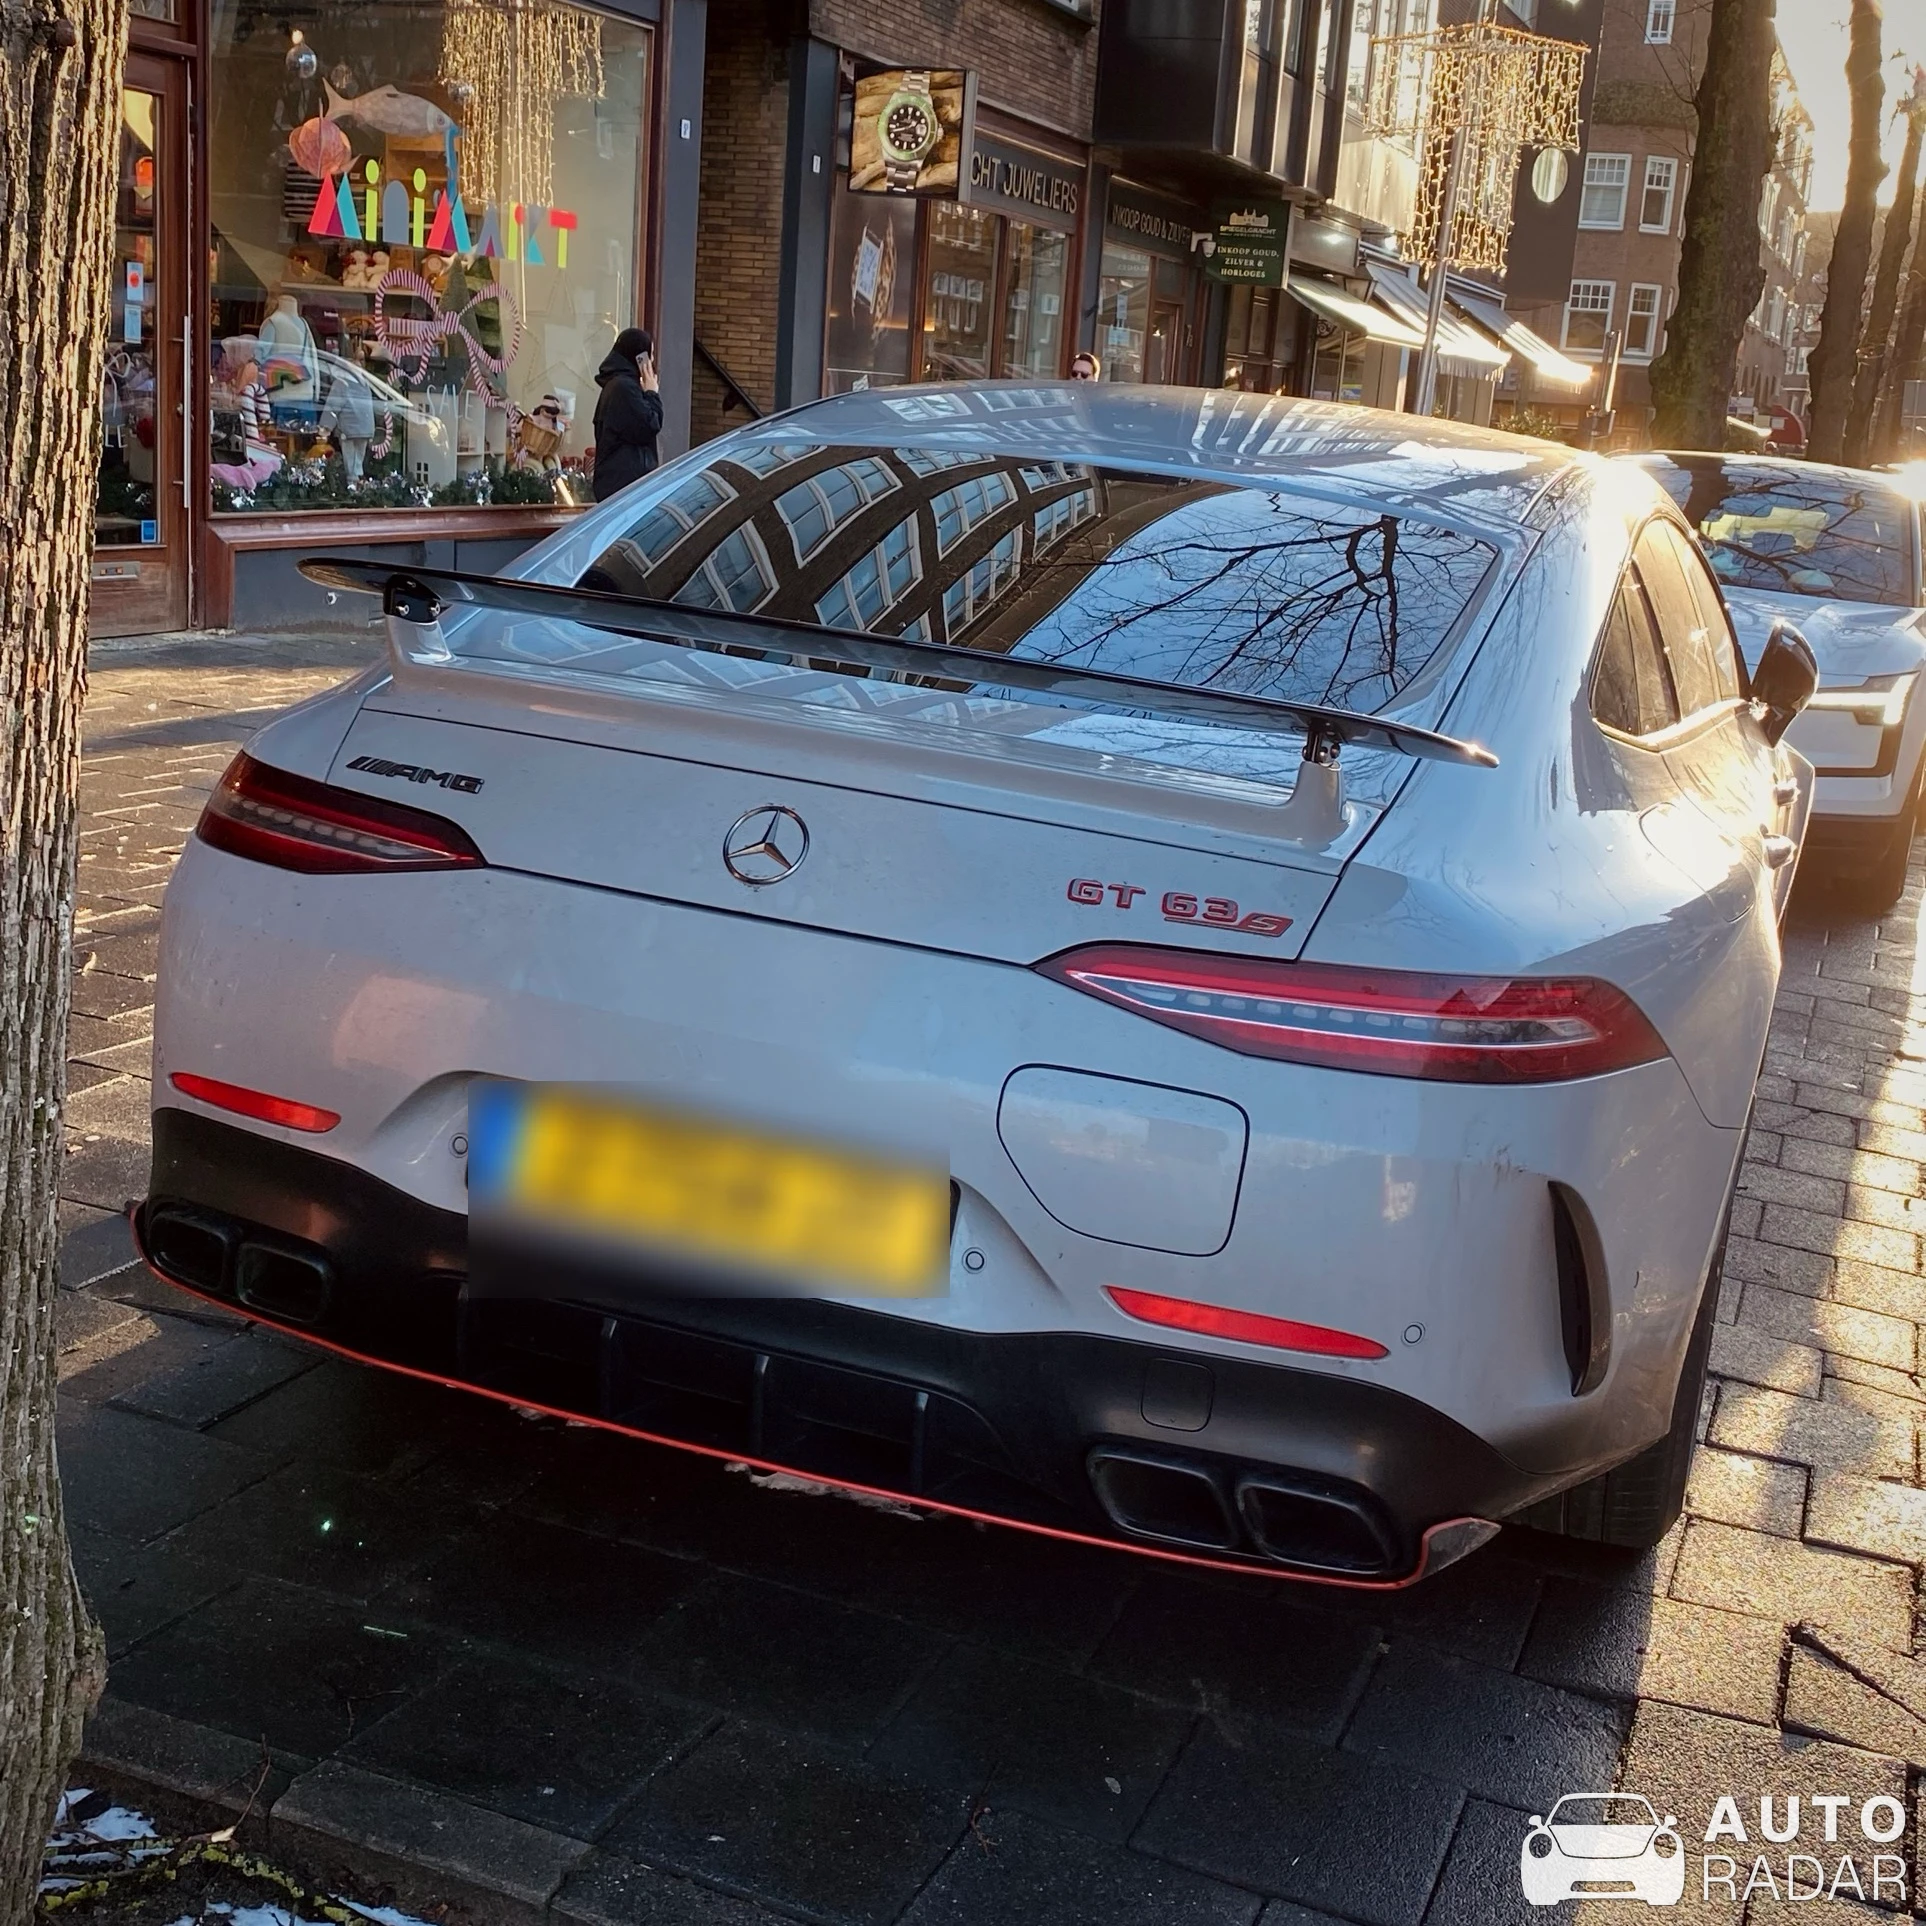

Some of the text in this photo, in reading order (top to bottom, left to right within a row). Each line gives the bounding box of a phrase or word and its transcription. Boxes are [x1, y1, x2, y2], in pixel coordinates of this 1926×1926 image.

[970, 151, 1079, 214] CHT JUWELIERS
[1217, 246, 1280, 258] INKOOP GOUD,
[1224, 257, 1265, 268] ZILVER &
[1220, 268, 1266, 278] HORLOGES
[426, 383, 474, 421] SALE
[1067, 878, 1147, 909] GT
